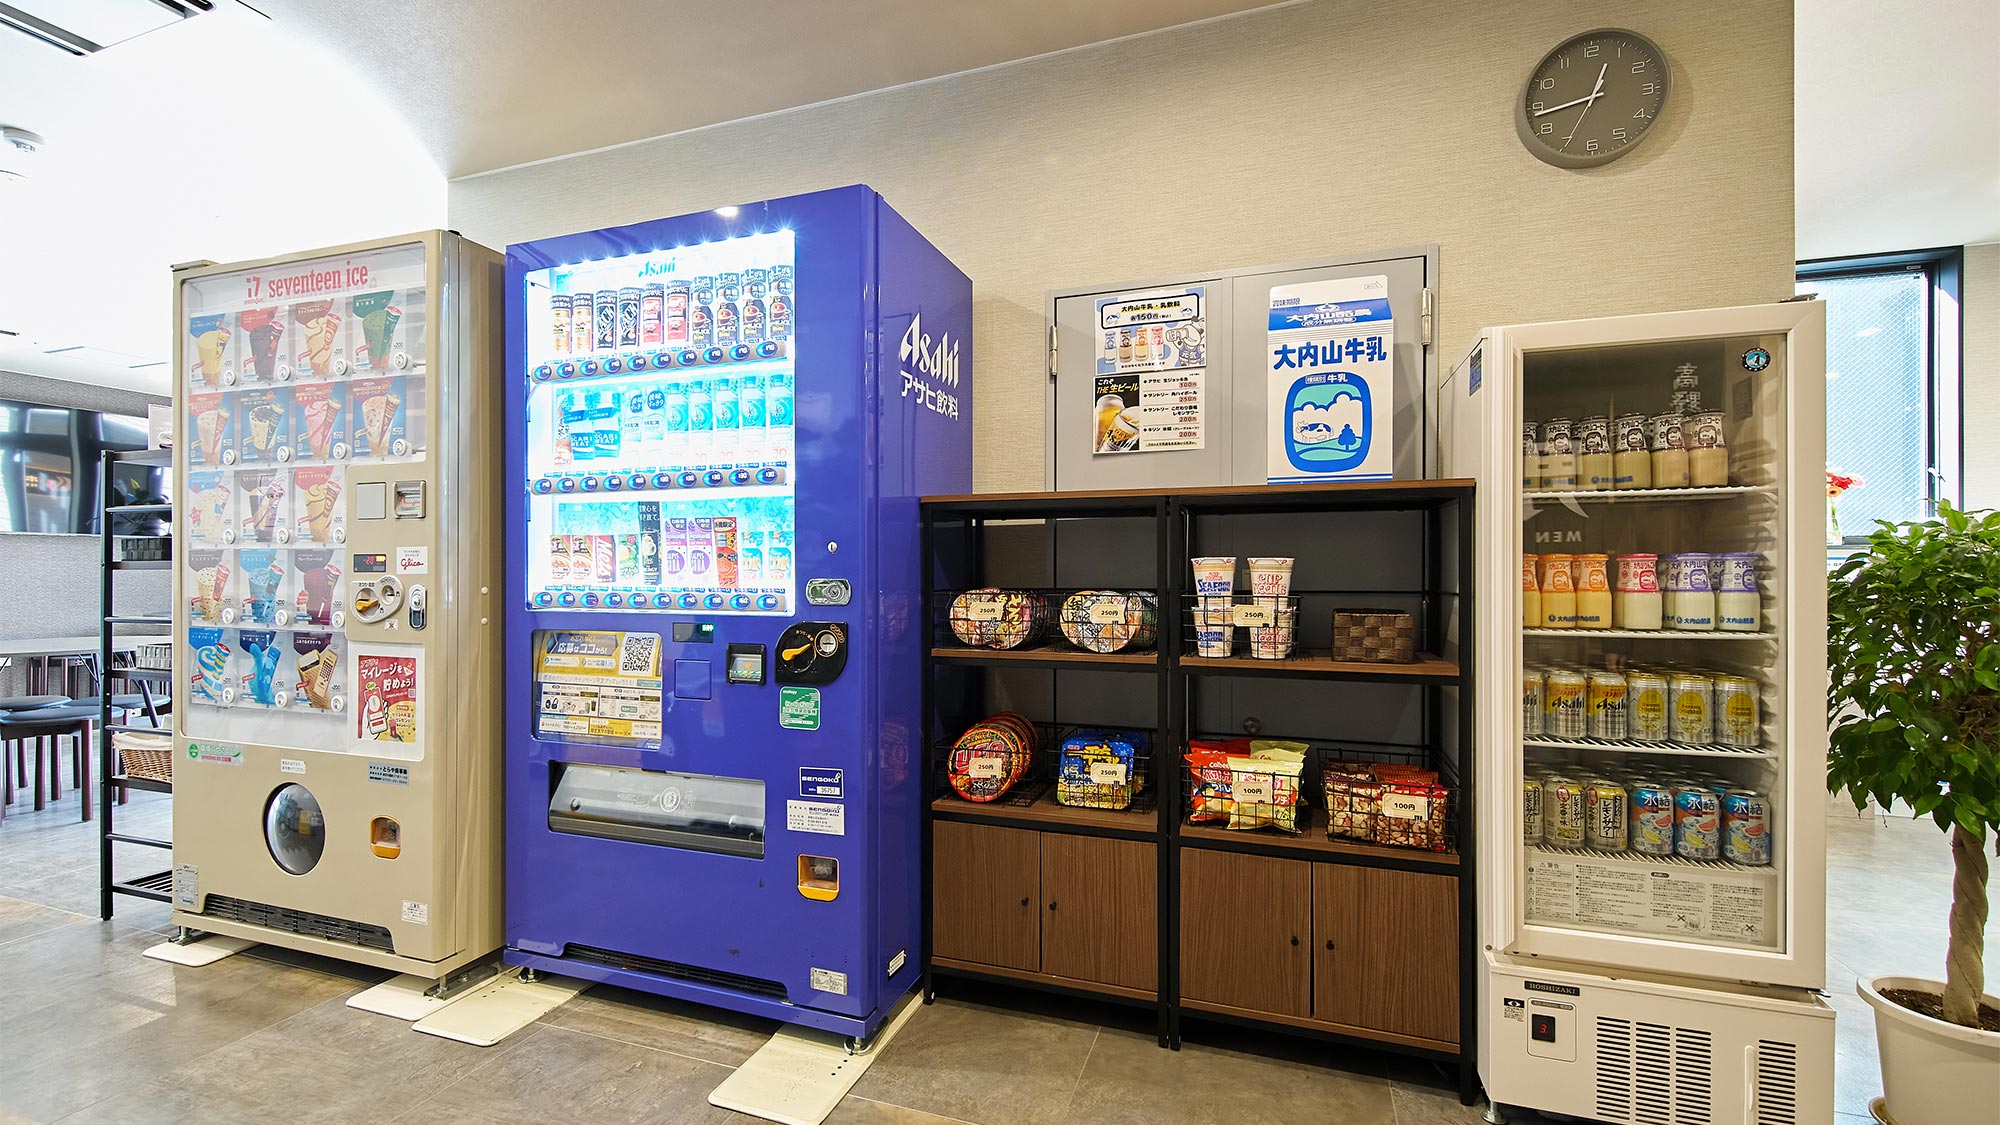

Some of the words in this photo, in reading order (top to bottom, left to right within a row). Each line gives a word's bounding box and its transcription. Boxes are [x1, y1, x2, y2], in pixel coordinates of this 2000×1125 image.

[1584, 45, 1599, 58] 12
[1617, 47, 1621, 58] 1
[1561, 57, 1570, 69] 11
[1631, 61, 1645, 74] 2
[1540, 78, 1555, 90] 10
[1642, 82, 1654, 95] 3
[1532, 101, 1544, 113] 9
[1632, 108, 1645, 119] 4
[1540, 122, 1553, 135] 8
[1612, 128, 1626, 140] 5
[1561, 136, 1573, 147] 7
[1586, 139, 1598, 151] 6
[268, 269, 341, 299] seventeen
[346, 260, 368, 287] ice
[900, 312, 959, 389] Asahi
[1273, 336, 1387, 370] 大内山牛乳
[1097, 378, 1114, 386] これぞ
[1327, 373, 1348, 383] 牛乳
[1109, 382, 1139, 393] 生ビール
[900, 369, 958, 421] アサヒ飲料
[401, 558, 424, 570] Glico
[1198, 578, 1231, 592] SEAFOOD
[1257, 573, 1283, 585] CUP
[1244, 611, 1264, 619] 250円
[361, 662, 403, 680] マイレージを
[383, 677, 414, 692] 貯めよう!
[801, 775, 840, 784] SENGOKU
[1243, 787, 1263, 795] 100円
[1644, 793, 1670, 807] 氷結
[1687, 797, 1715, 811] 氷結
[1393, 802, 1416, 811] 100円
[1733, 800, 1763, 815] 氷結
[1602, 800, 1612, 836] レモンサワー
[1528, 982, 1576, 995] HOSHIZAKI
[1539, 1023, 1547, 1033] 3
